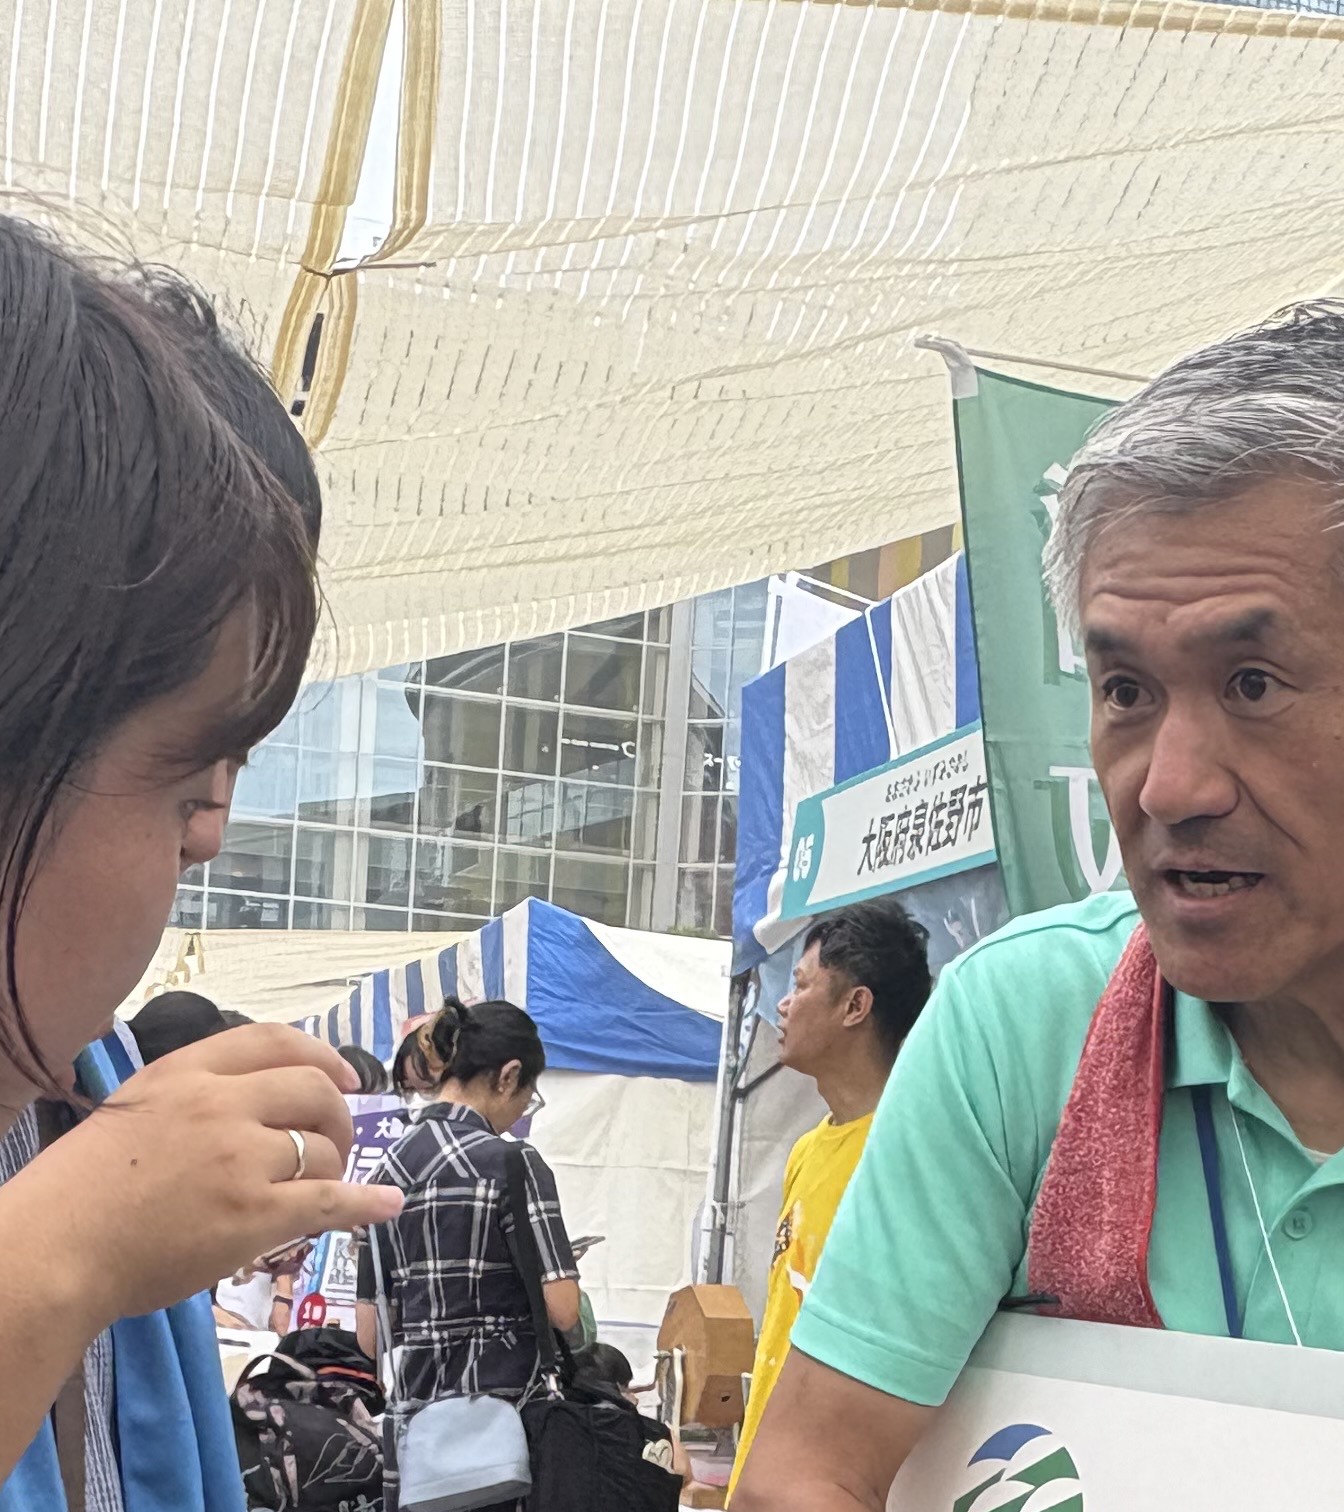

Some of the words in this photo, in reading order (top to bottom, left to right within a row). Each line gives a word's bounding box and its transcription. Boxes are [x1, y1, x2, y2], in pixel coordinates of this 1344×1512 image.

[857, 774, 988, 876] 大阪府泉佐野市
